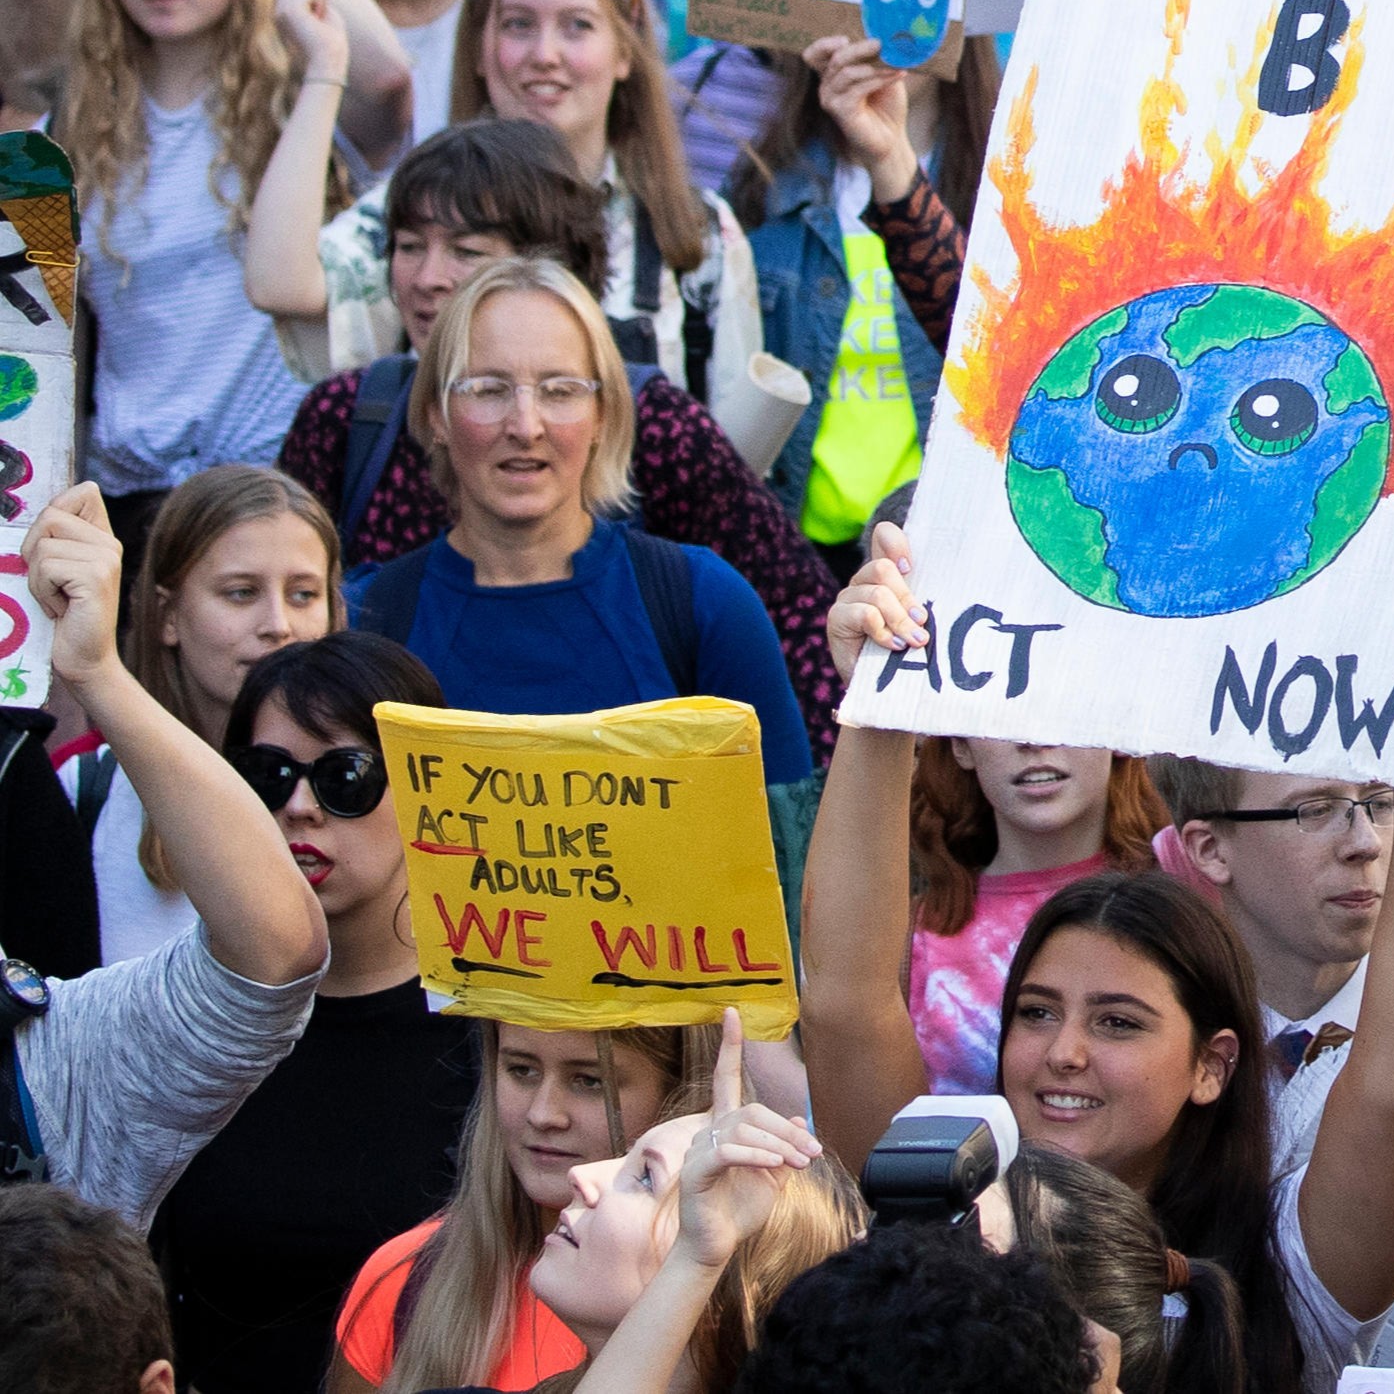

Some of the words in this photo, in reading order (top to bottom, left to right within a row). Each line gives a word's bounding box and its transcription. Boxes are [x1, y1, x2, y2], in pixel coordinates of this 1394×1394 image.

[876, 600, 1064, 700] ACT
[407, 751, 444, 794] IF
[461, 761, 550, 806] YOU
[414, 804, 489, 854] ACT
[514, 818, 613, 860] LIKE
[469, 854, 634, 907] ADULTS,
[433, 892, 554, 968] WE
[590, 919, 782, 973] WILL
